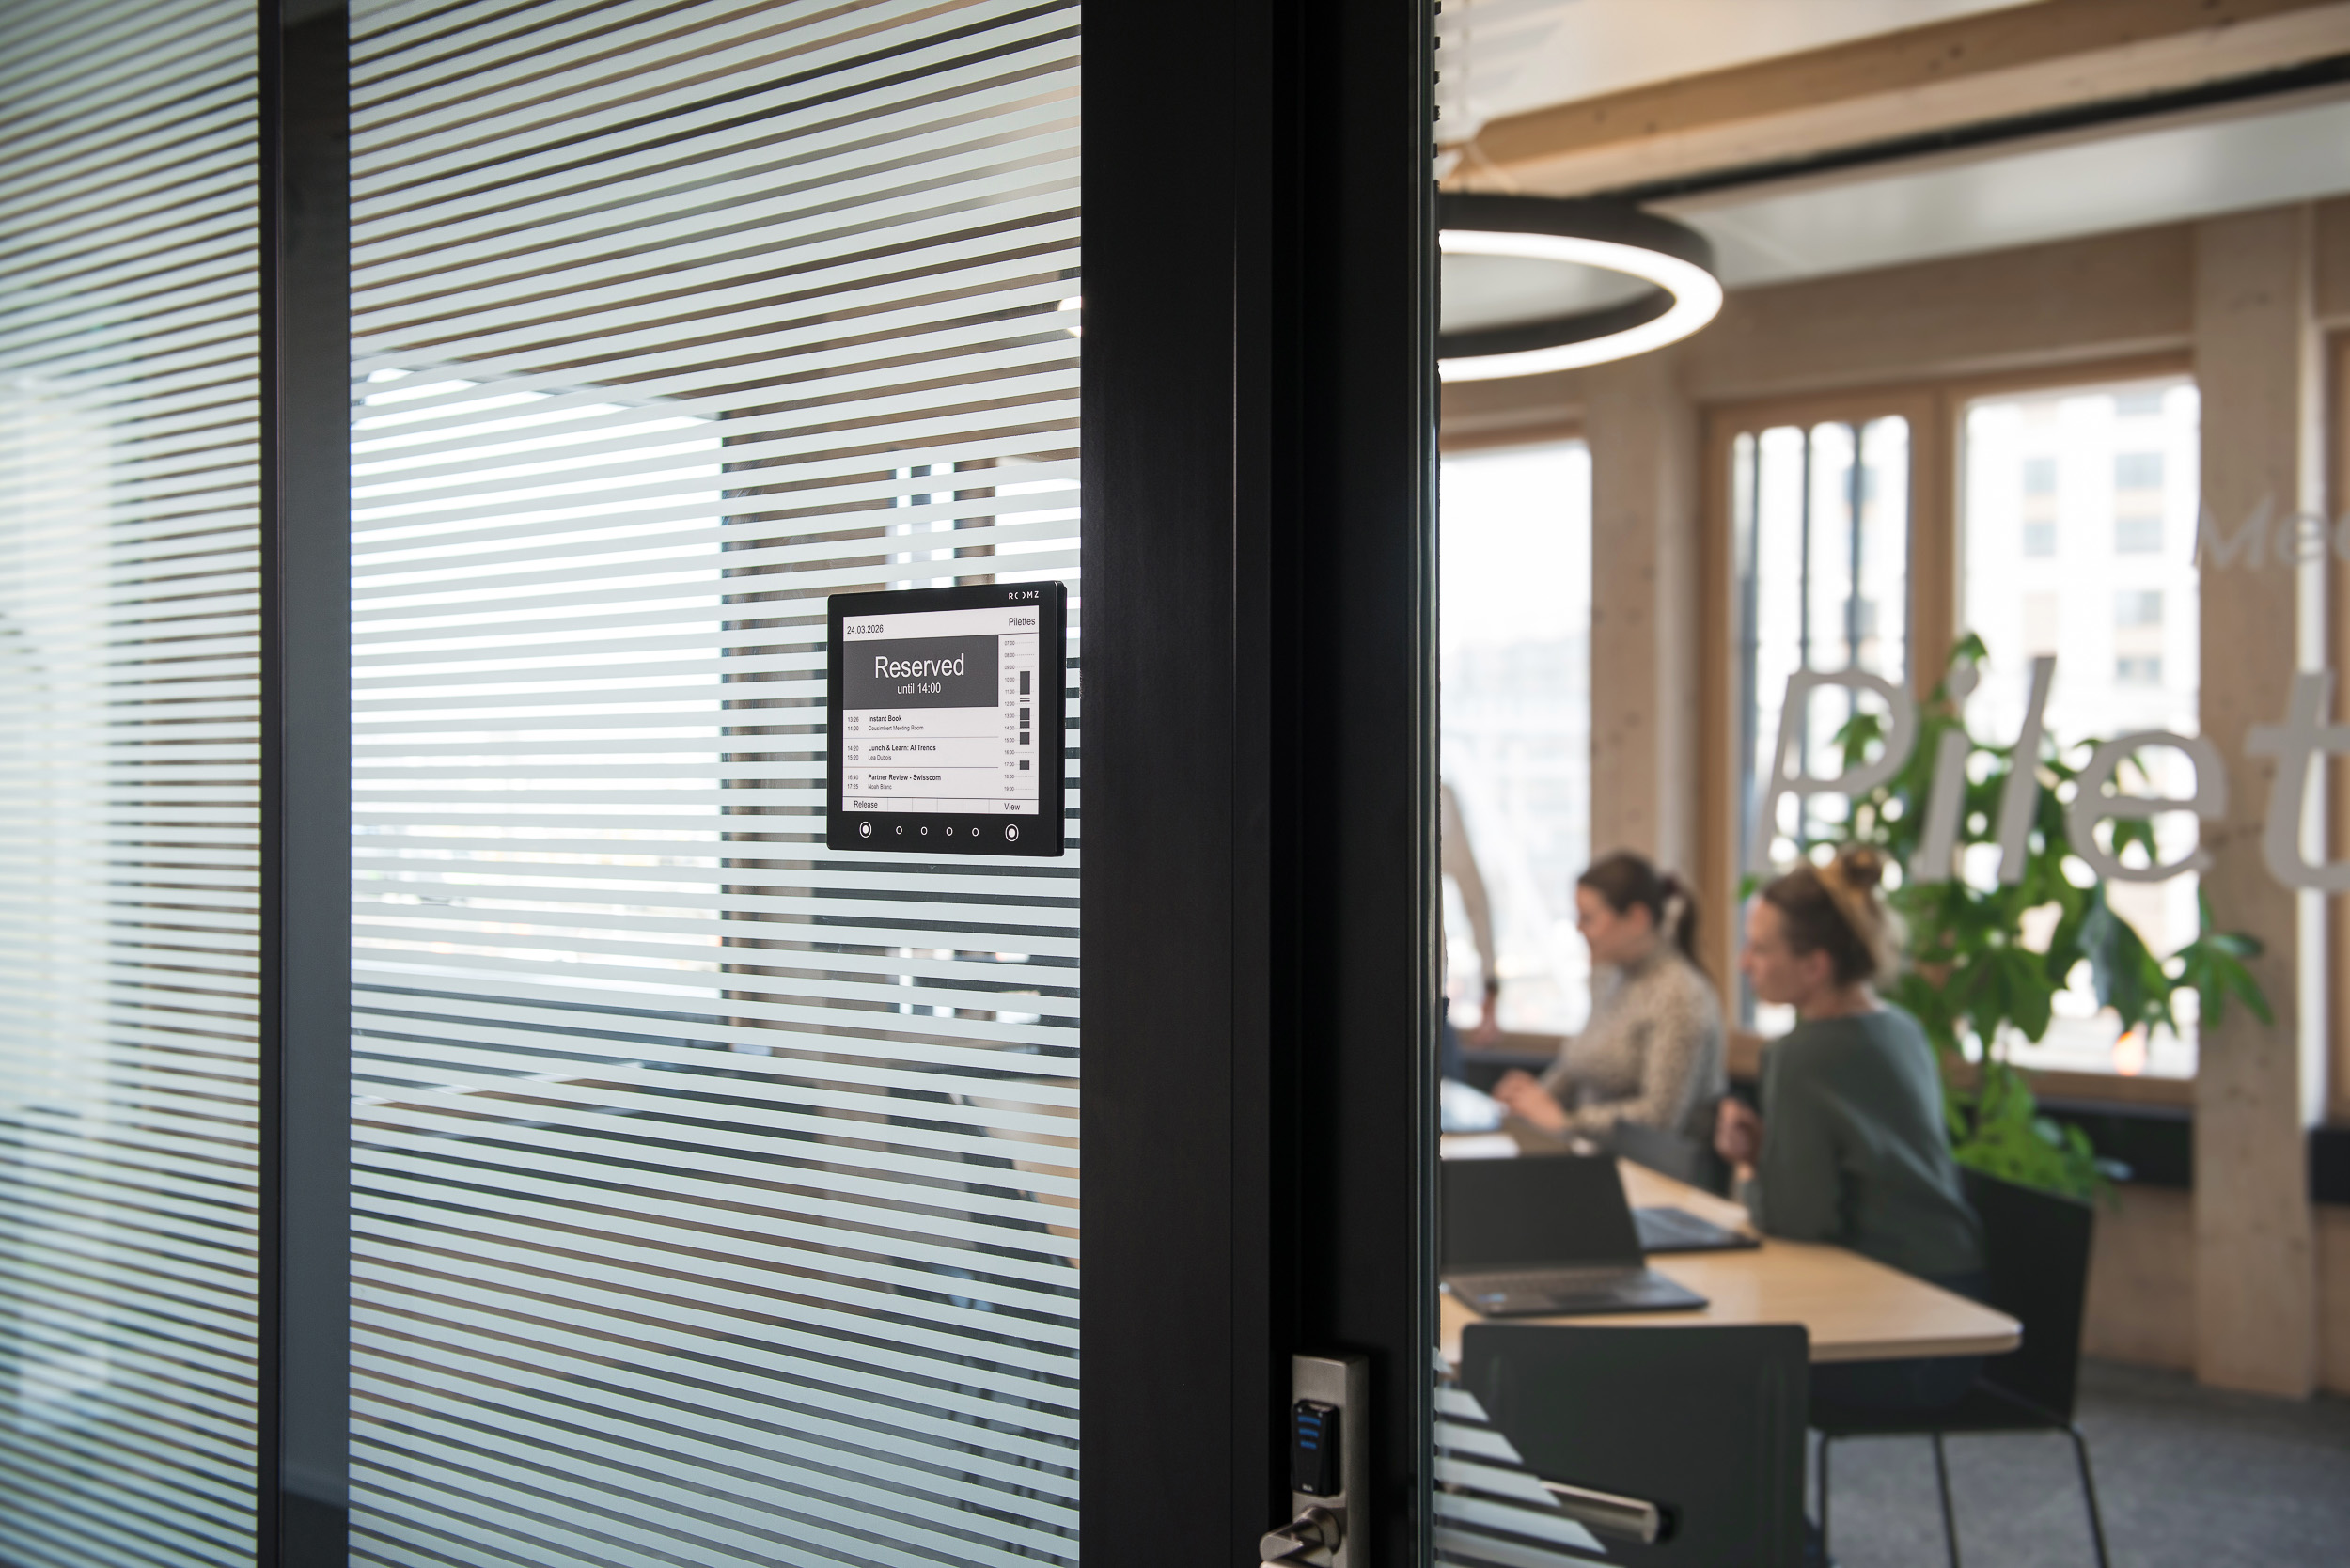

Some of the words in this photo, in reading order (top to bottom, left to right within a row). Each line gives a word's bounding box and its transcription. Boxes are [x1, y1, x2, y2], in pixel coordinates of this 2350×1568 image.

[1009, 617, 1036, 627] Pilettes
[847, 624, 885, 635] 24.03.2026
[875, 652, 964, 679] Reserved
[897, 683, 915, 694] until
[917, 682, 941, 694] 14:00
[1752, 655, 2350, 893] Pilet
[854, 800, 878, 808] Release
